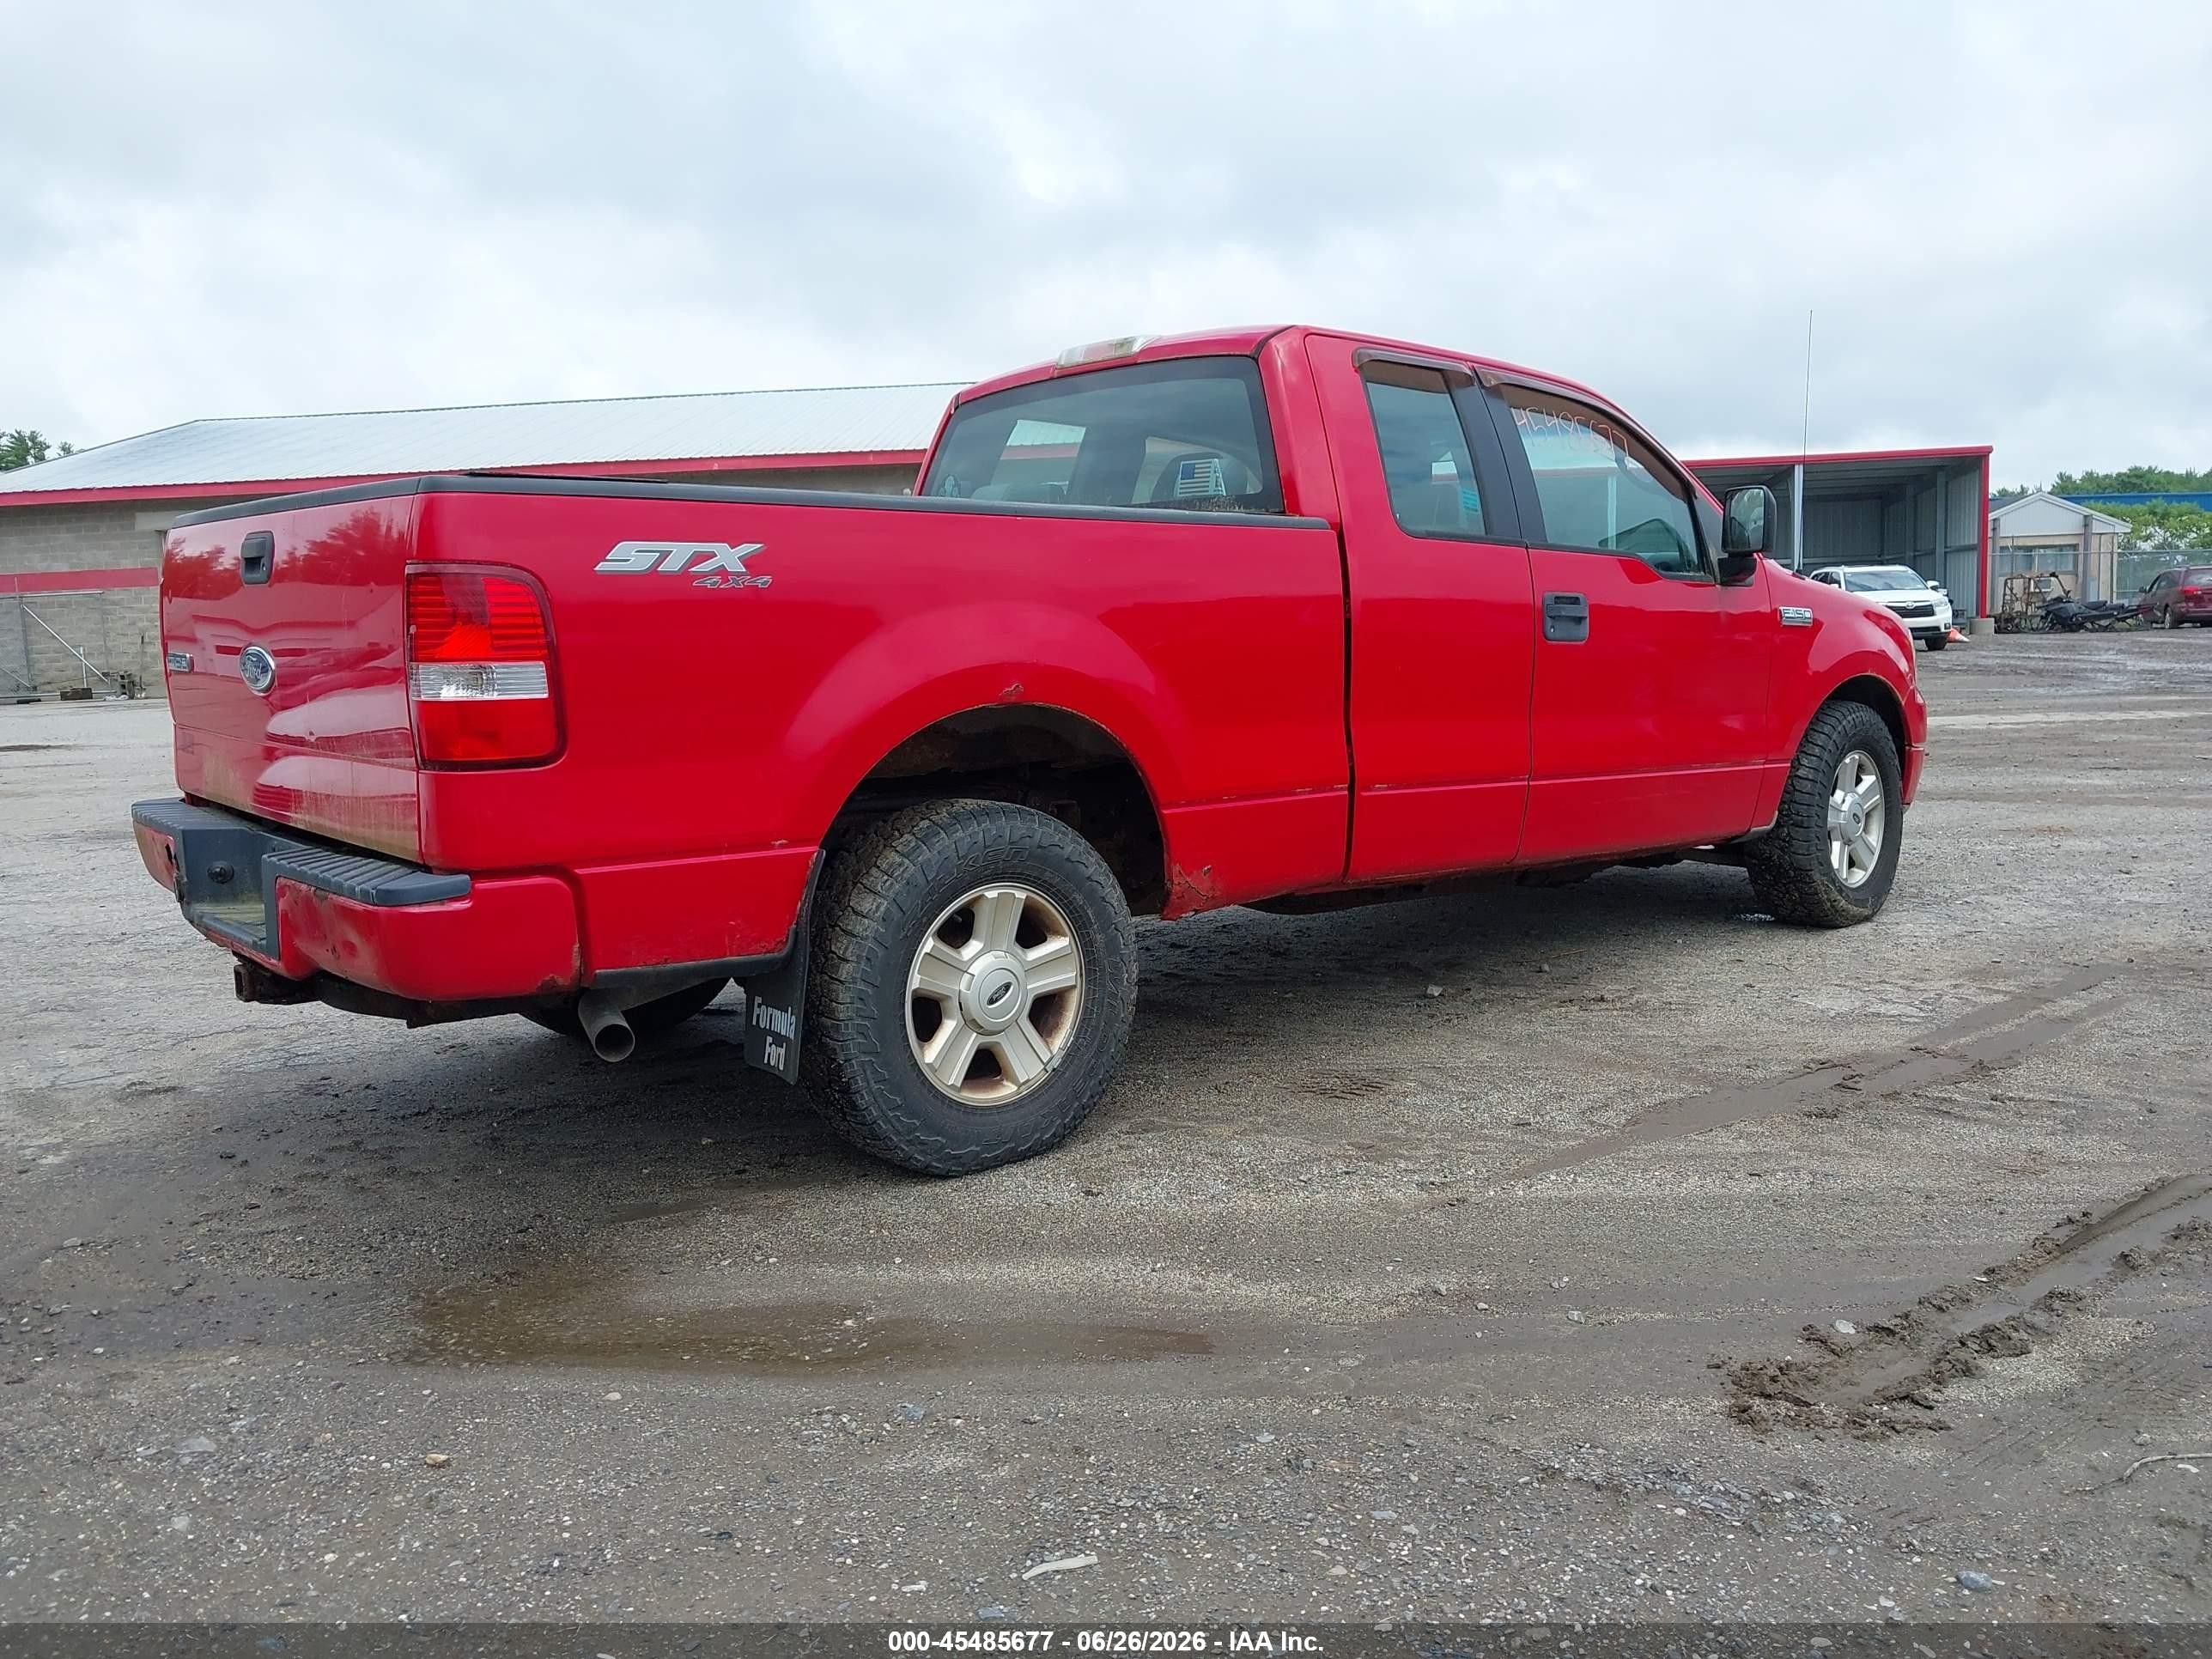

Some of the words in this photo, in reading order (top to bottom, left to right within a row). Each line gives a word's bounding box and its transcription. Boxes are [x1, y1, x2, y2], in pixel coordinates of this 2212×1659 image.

[593, 541, 767, 574] STX
[752, 995, 795, 1041] Formula
[763, 1036, 786, 1071] Ford
